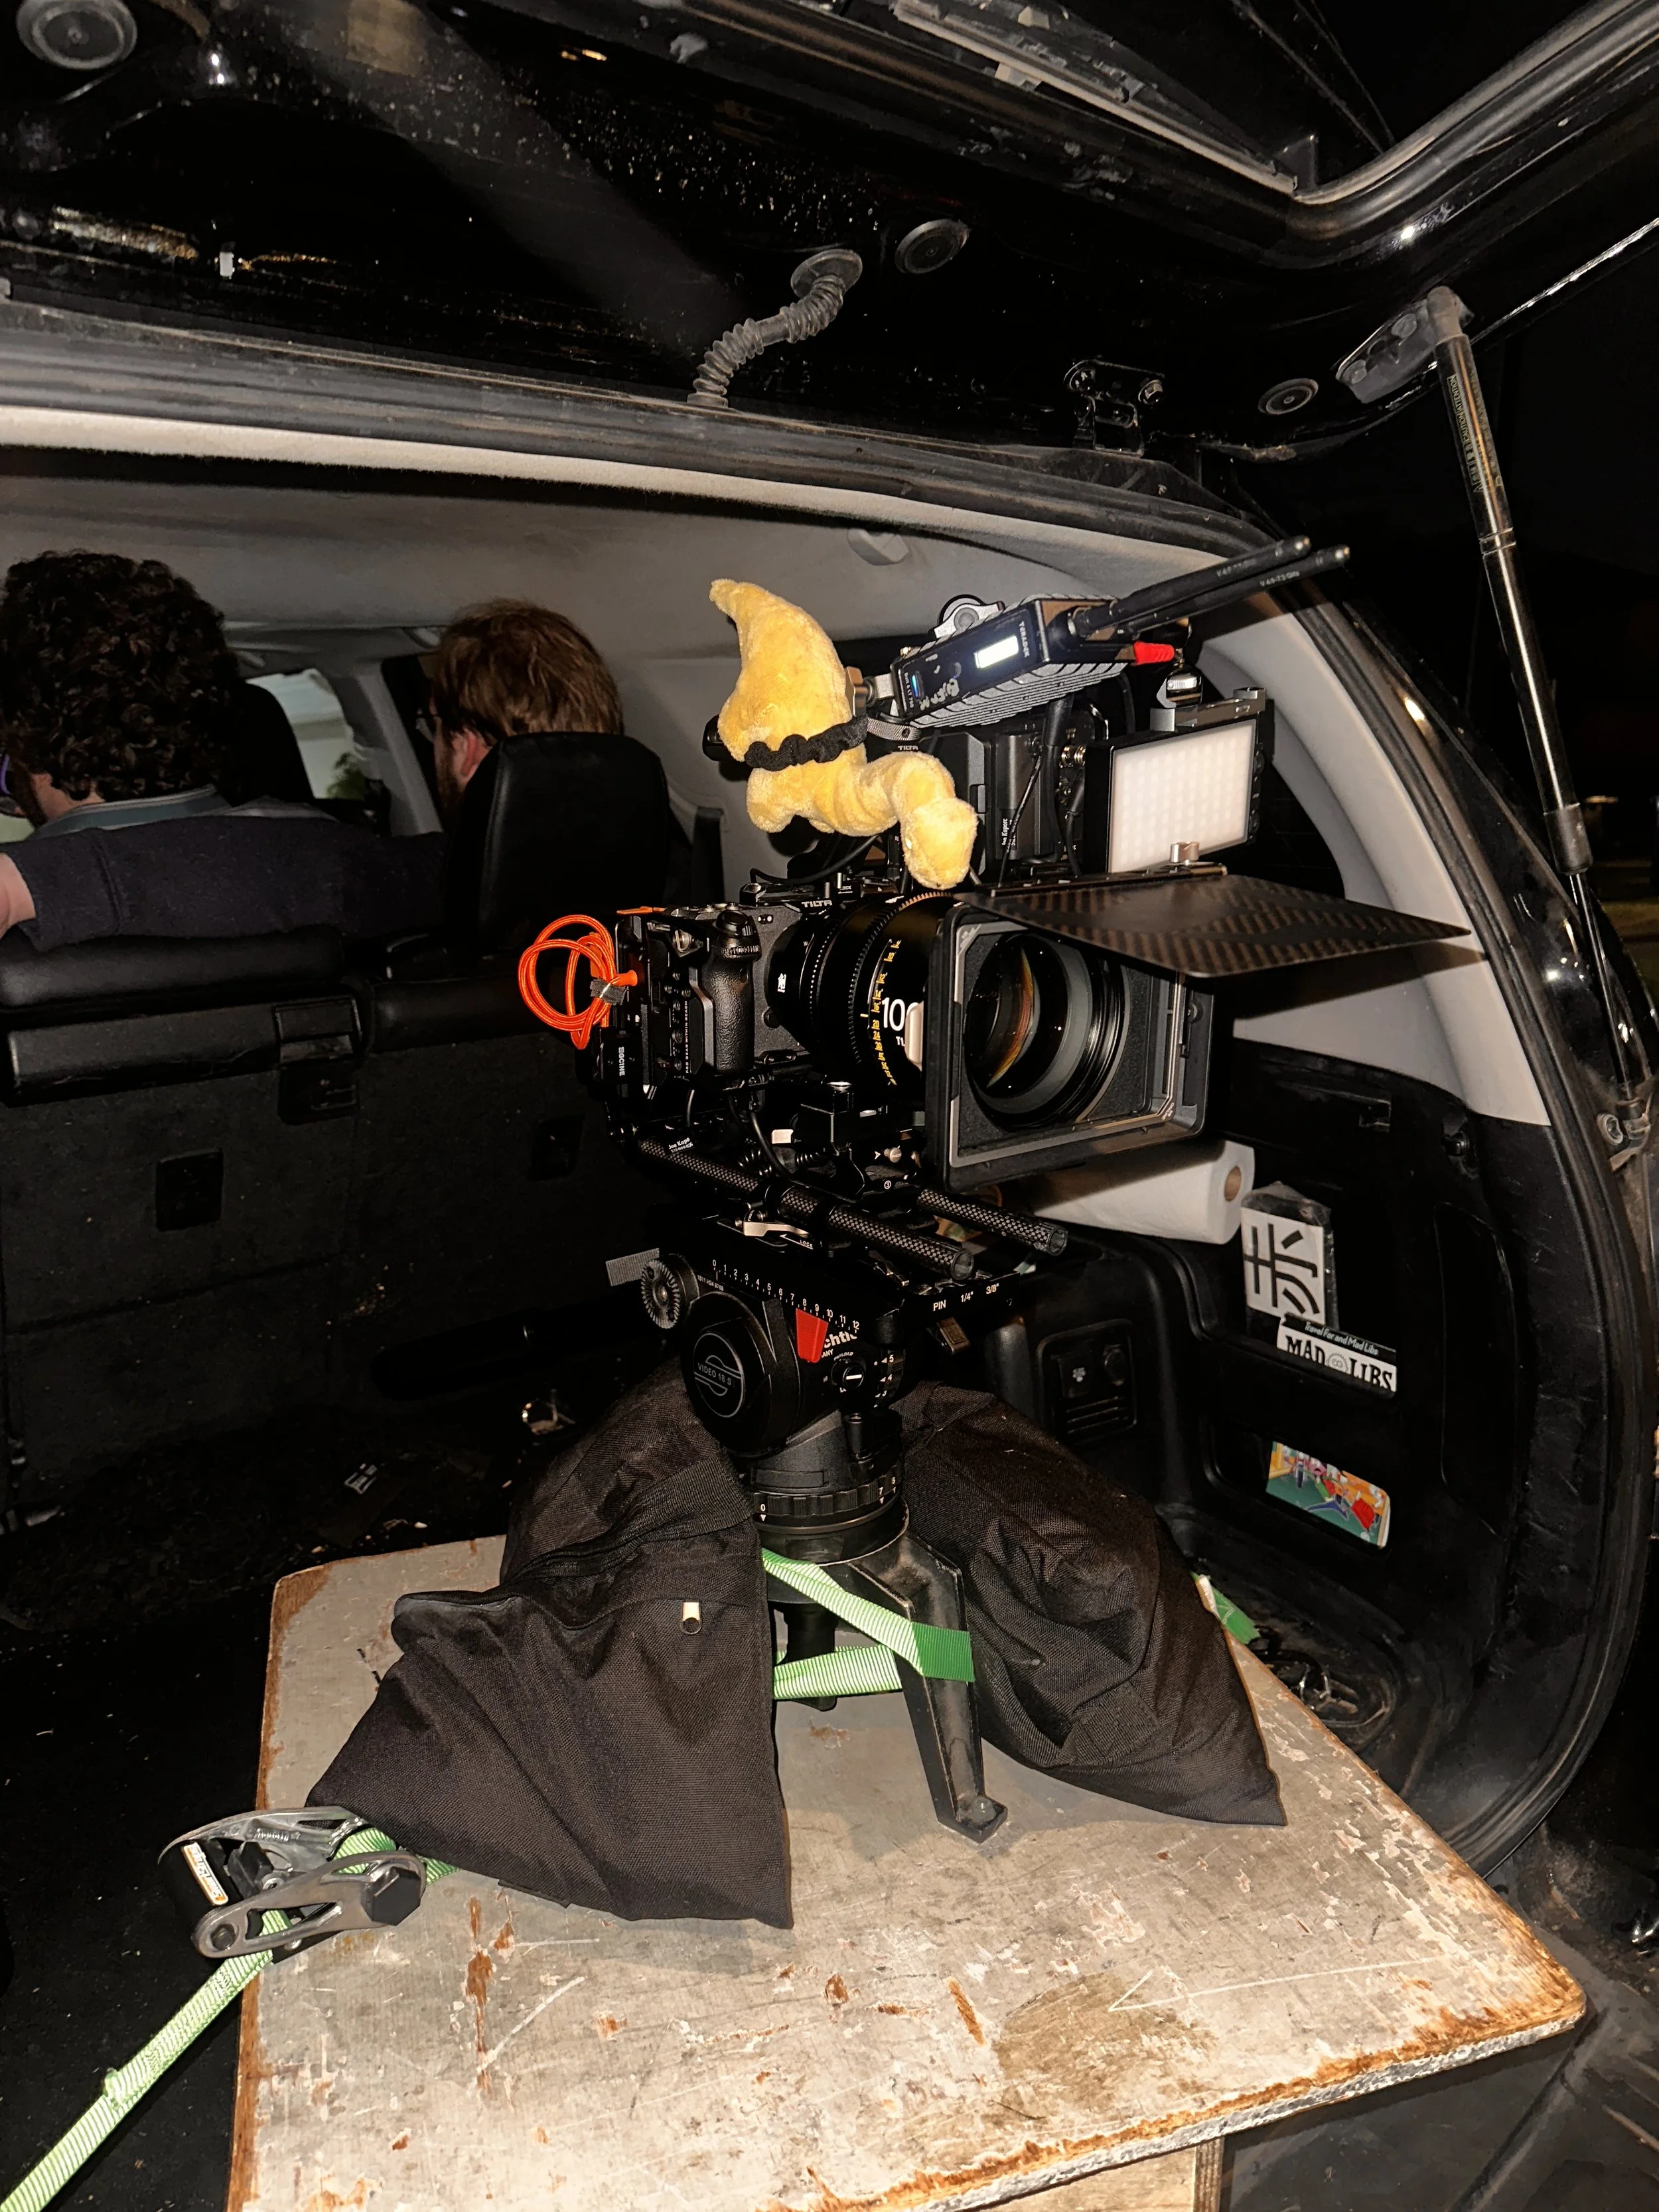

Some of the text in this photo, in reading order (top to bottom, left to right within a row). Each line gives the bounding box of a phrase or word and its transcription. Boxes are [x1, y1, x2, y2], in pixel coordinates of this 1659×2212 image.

[1019, 621, 1030, 658] TERADEK
[882, 997, 919, 1031] 10
[800, 1239, 813, 1248] LOCK
[1243, 1223, 1319, 1314] 赤
[933, 1283, 999, 1311] PIN 1/4" 3/8"
[815, 1303, 819, 1312] 9
[826, 1309, 833, 1318] 10
[839, 1315, 846, 1323] 11
[852, 1320, 859, 1329] 12
[1305, 1321, 1323, 1336] Travel
[1334, 1333, 1347, 1345] and
[1348, 1336, 1364, 1351] Mad
[1364, 1343, 1379, 1355] Libs
[697, 1363, 716, 1378] VIDEO
[718, 1373, 725, 1382] 18
[1285, 1335, 1392, 1390] MAD LIBS
[760, 1503, 766, 1512] 0
[879, 1487, 884, 1495] 7
